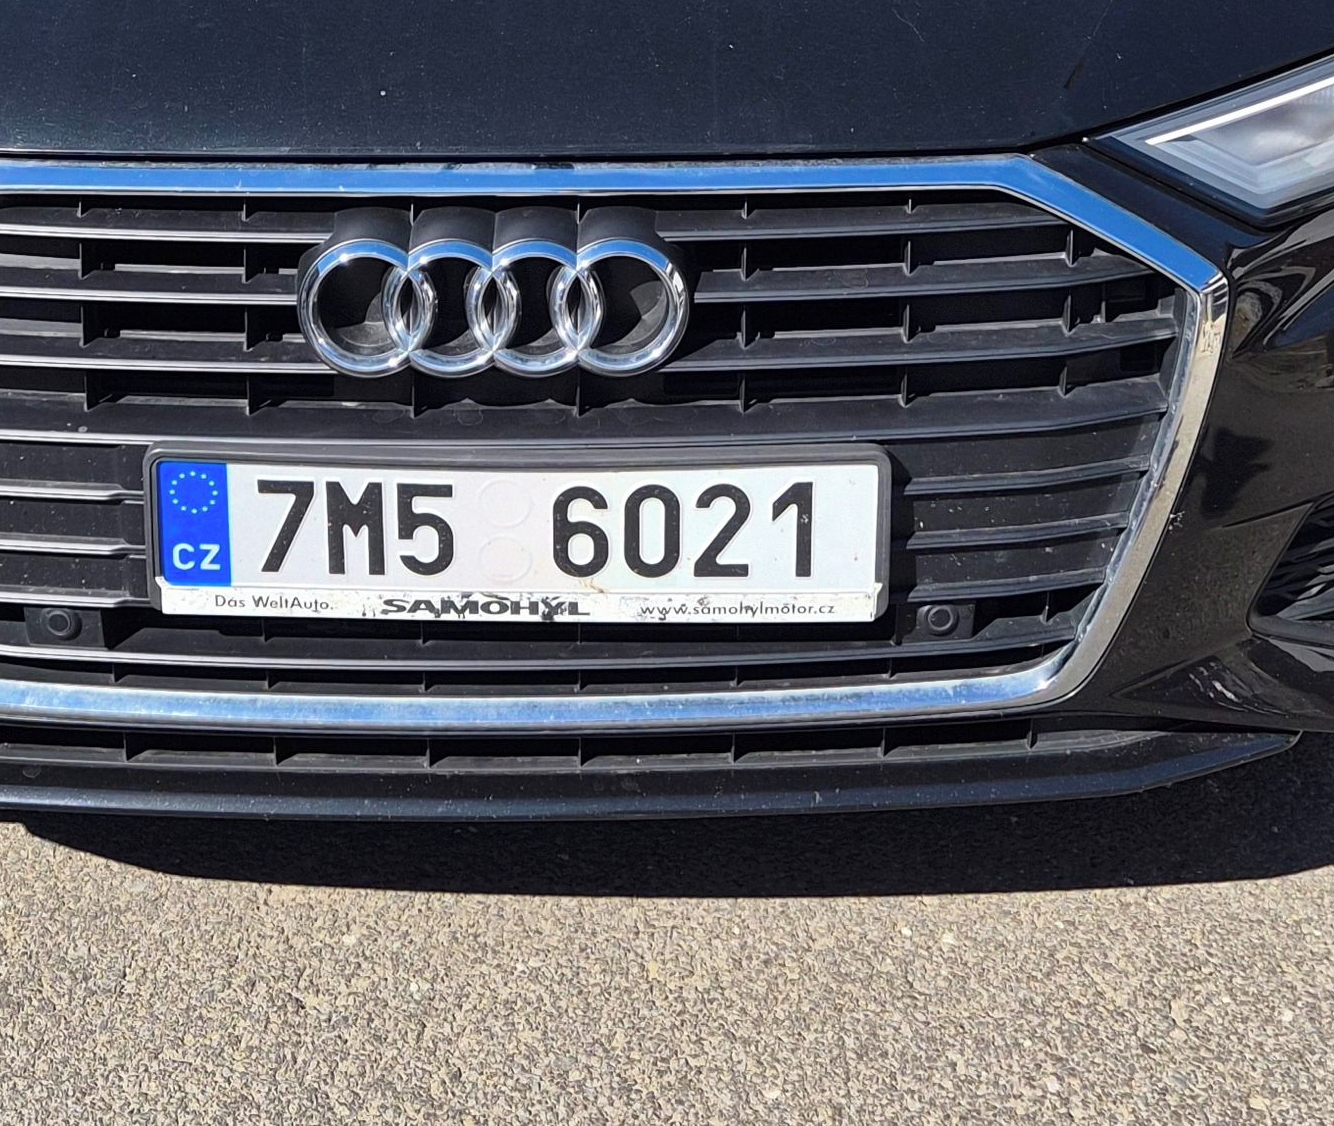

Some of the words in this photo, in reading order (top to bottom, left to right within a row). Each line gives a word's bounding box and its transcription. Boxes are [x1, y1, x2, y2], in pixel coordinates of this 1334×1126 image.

[257, 479, 454, 576] 7M5
[552, 481, 814, 578] 6021
[172, 543, 221, 571] CZ
[214, 595, 246, 608] Das
